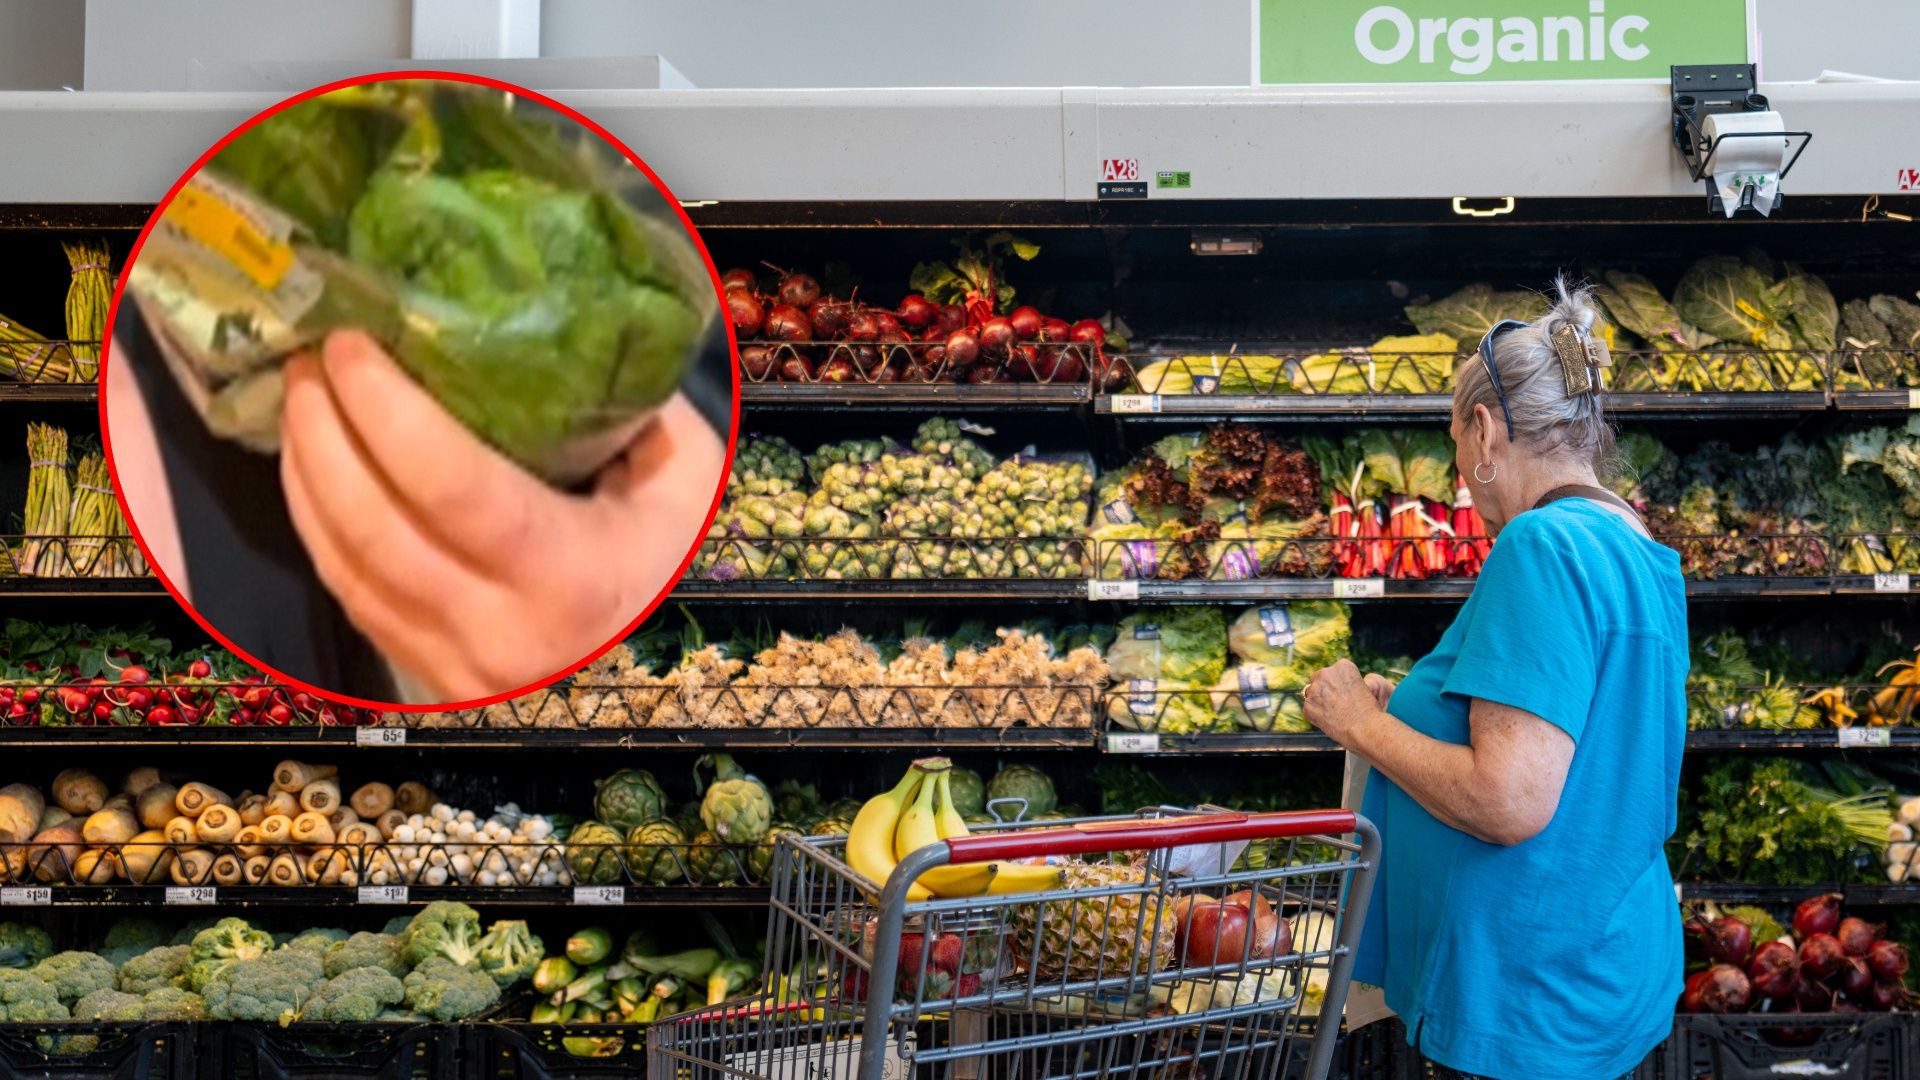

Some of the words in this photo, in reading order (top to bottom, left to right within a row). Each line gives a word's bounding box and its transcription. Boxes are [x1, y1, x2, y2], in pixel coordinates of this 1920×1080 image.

[1354, 0, 1650, 75] Organic
[1104, 159, 1138, 181] A28
[383, 730, 402, 742] 65¢
[190, 888, 214, 901] $298
